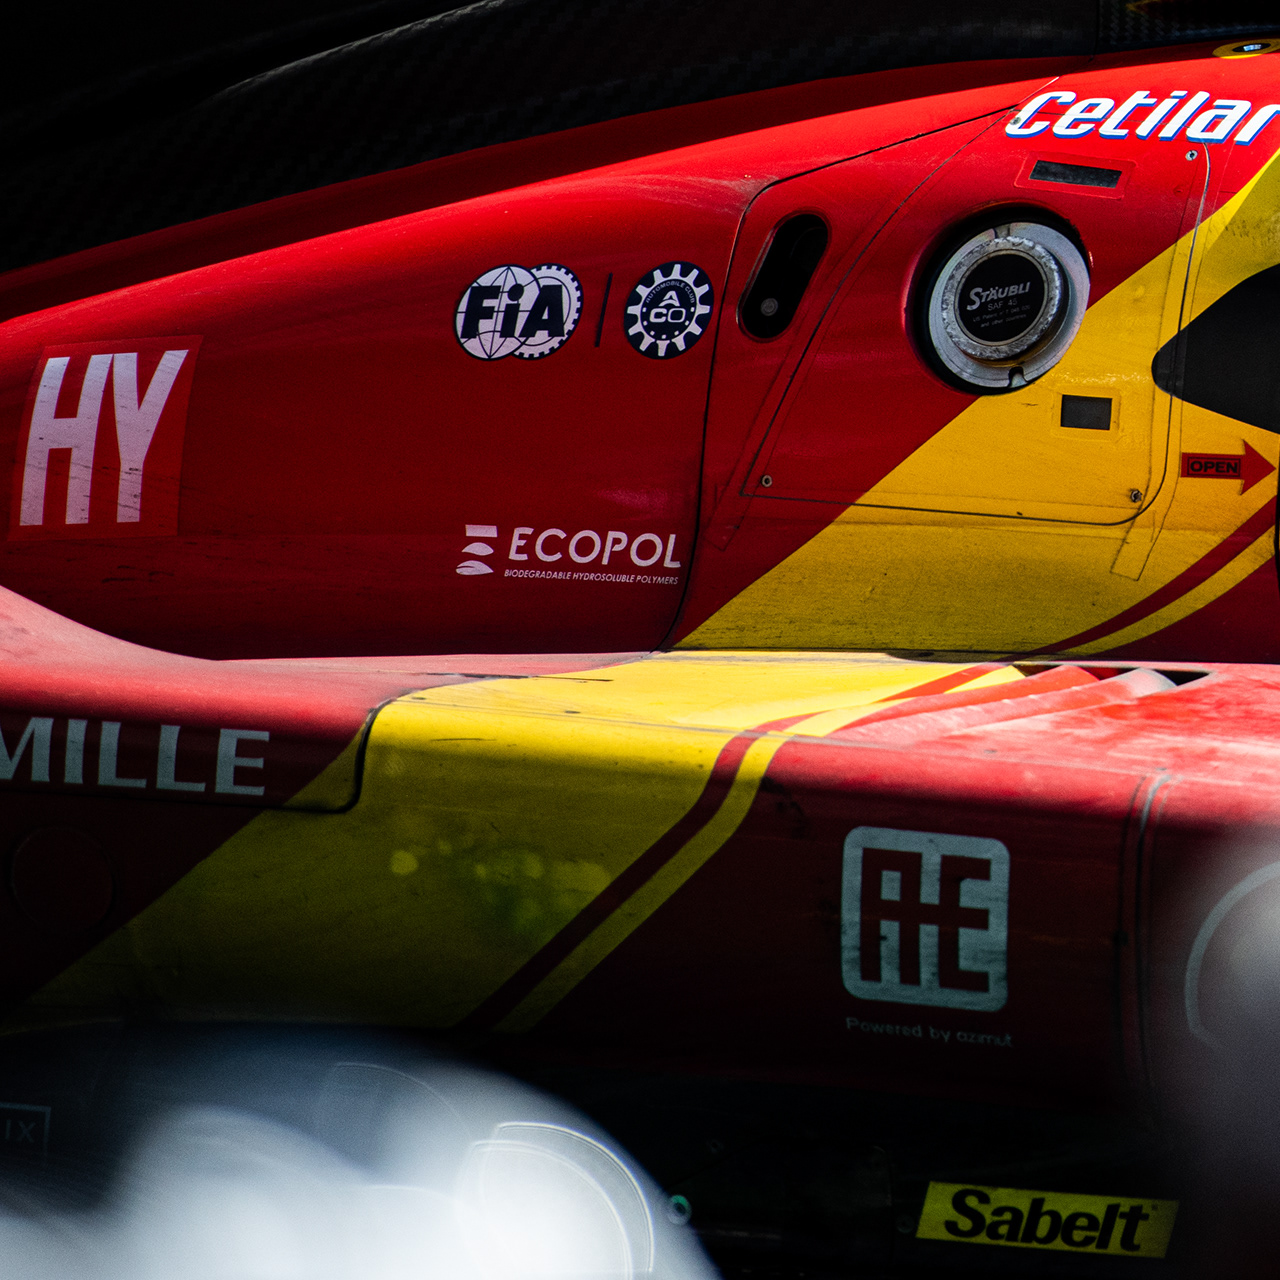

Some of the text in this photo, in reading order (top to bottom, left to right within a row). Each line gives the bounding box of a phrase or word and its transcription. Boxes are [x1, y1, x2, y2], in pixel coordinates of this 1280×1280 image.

[19, 349, 190, 526] HY
[1190, 461, 1238, 473] OPEN
[508, 527, 682, 568] ECOPOL
[504, 569, 678, 585] BIODEGRADABLE HYDROSOLUBLE POLYMERS
[0, 717, 271, 796] MILLE
[846, 1017, 922, 1038] Powered
[929, 1026, 951, 1043] by
[944, 1188, 1150, 1252] Sabelt
